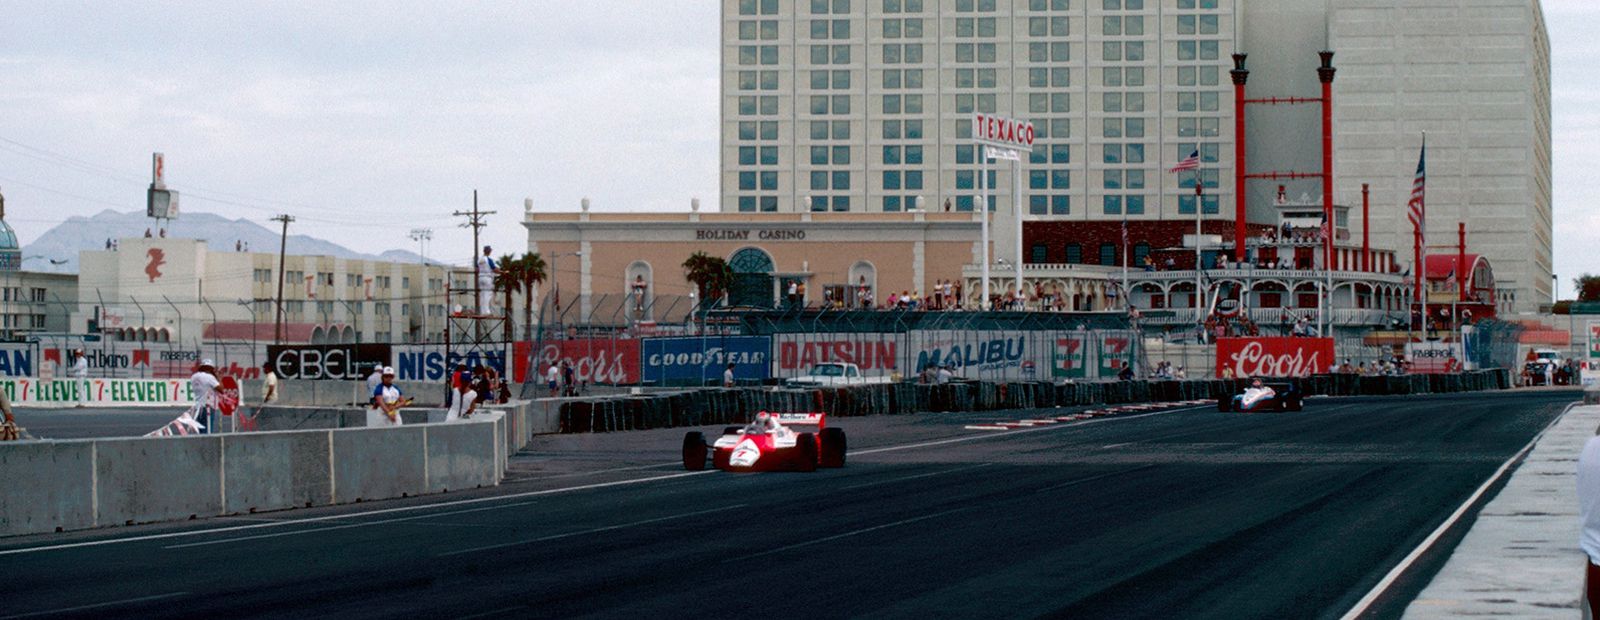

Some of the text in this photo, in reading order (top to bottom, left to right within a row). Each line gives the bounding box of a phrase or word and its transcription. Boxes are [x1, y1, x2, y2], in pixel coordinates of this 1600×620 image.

[977, 115, 1034, 145] TEXACO
[696, 230, 806, 240] HOLIDAY CASINO
[66, 349, 129, 368] Mrlboro
[276, 349, 363, 379] EBEL
[781, 341, 895, 369] DATSUN
[916, 336, 1024, 373] MALIBU
[1231, 341, 1318, 378] Coors
